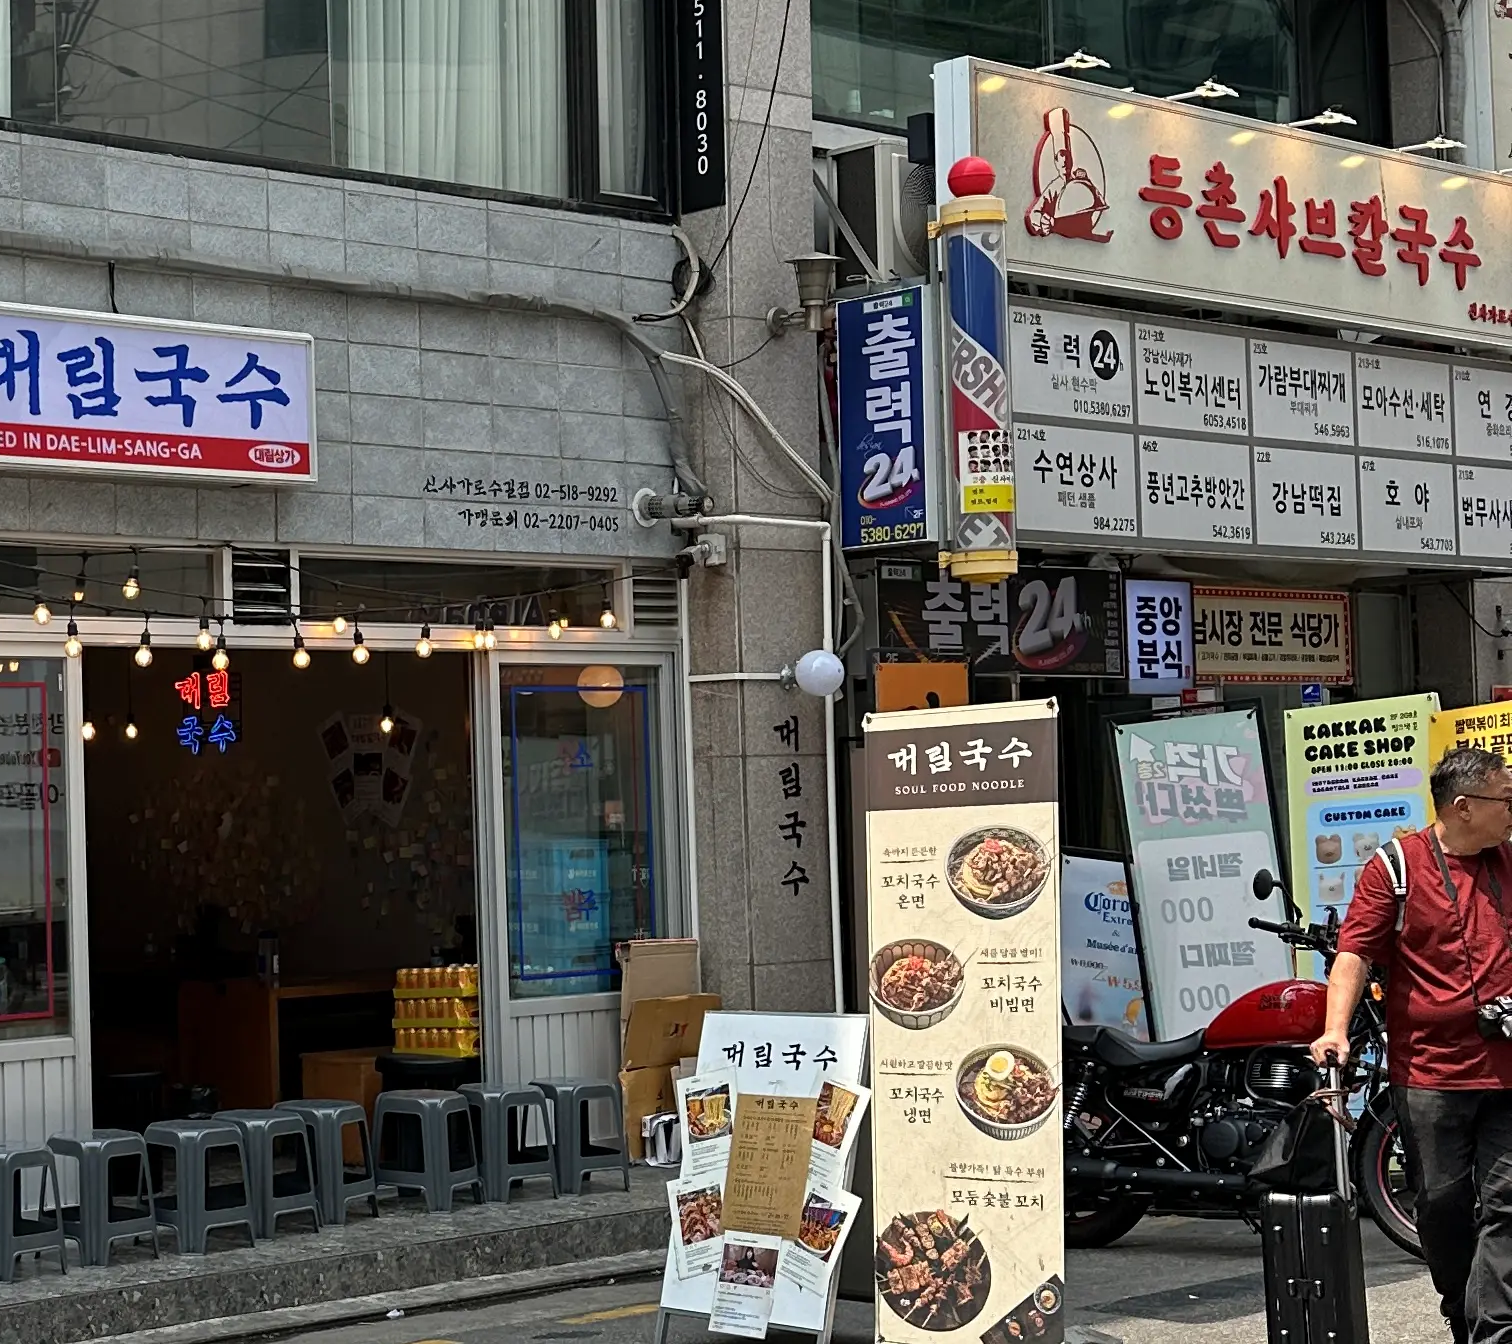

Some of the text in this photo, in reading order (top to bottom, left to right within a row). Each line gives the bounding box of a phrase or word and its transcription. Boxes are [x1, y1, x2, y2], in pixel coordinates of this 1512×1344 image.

[1139, 154, 1483, 291] 등촌샤브칼국수
[861, 313, 915, 444] 출력
[1144, 368, 1242, 410] 노인복지센터
[1258, 364, 1347, 404] 가람부대찌개
[23, 432, 41, 450] IN
[46, 433, 202, 460] DAE-LIM-SANG-GA
[252, 448, 297, 467] 대림상가
[862, 445, 920, 502] 24
[1032, 449, 1118, 490] 수연상사
[423, 474, 618, 503] 신사가로수길점 02-518-9292
[1146, 471, 1245, 511] 풍년고추방앗간
[1272, 481, 1342, 517] 강남떡집
[458, 509, 620, 533] 가맹문의 02-2207-0405
[912, 508, 924, 520] 2F
[860, 522, 925, 544] 5380-6297
[922, 576, 1009, 656] 출력
[1136, 595, 1183, 636] 중앙
[1249, 611, 1283, 647] 전문
[1290, 612, 1340, 648] 식당가
[1137, 639, 1183, 679] 분식
[175, 670, 230, 710] 대림
[176, 713, 237, 755] 국수
[1303, 716, 1388, 741] KAKKAK
[887, 737, 1033, 775] 대림국수
[1304, 735, 1416, 762] CAKE SHOP
[1311, 764, 1332, 775] OPEN
[1360, 759, 1386, 770] CLOSE
[1388, 757, 1413, 768] 20:00
[895, 778, 1025, 795] SOUL FOOD NOODLE
[773, 715, 810, 897] 대림국수
[1324, 806, 1406, 823] CUSTOM CAKE
[880, 873, 941, 890] 꼬치국수
[895, 894, 926, 909] 온면
[1084, 891, 1131, 915] Coro
[980, 974, 1043, 993] 꼬치국수
[989, 996, 1036, 1013] 비빔면
[721, 1040, 838, 1072] 대림국수
[879, 1058, 916, 1069] 시원하고
[755, 1098, 799, 1111] 대림국수
[888, 1086, 945, 1104] 꼬치국수
[903, 1108, 932, 1125] 냉면
[950, 1187, 1044, 1211] 모둠 숯불 꼬치
